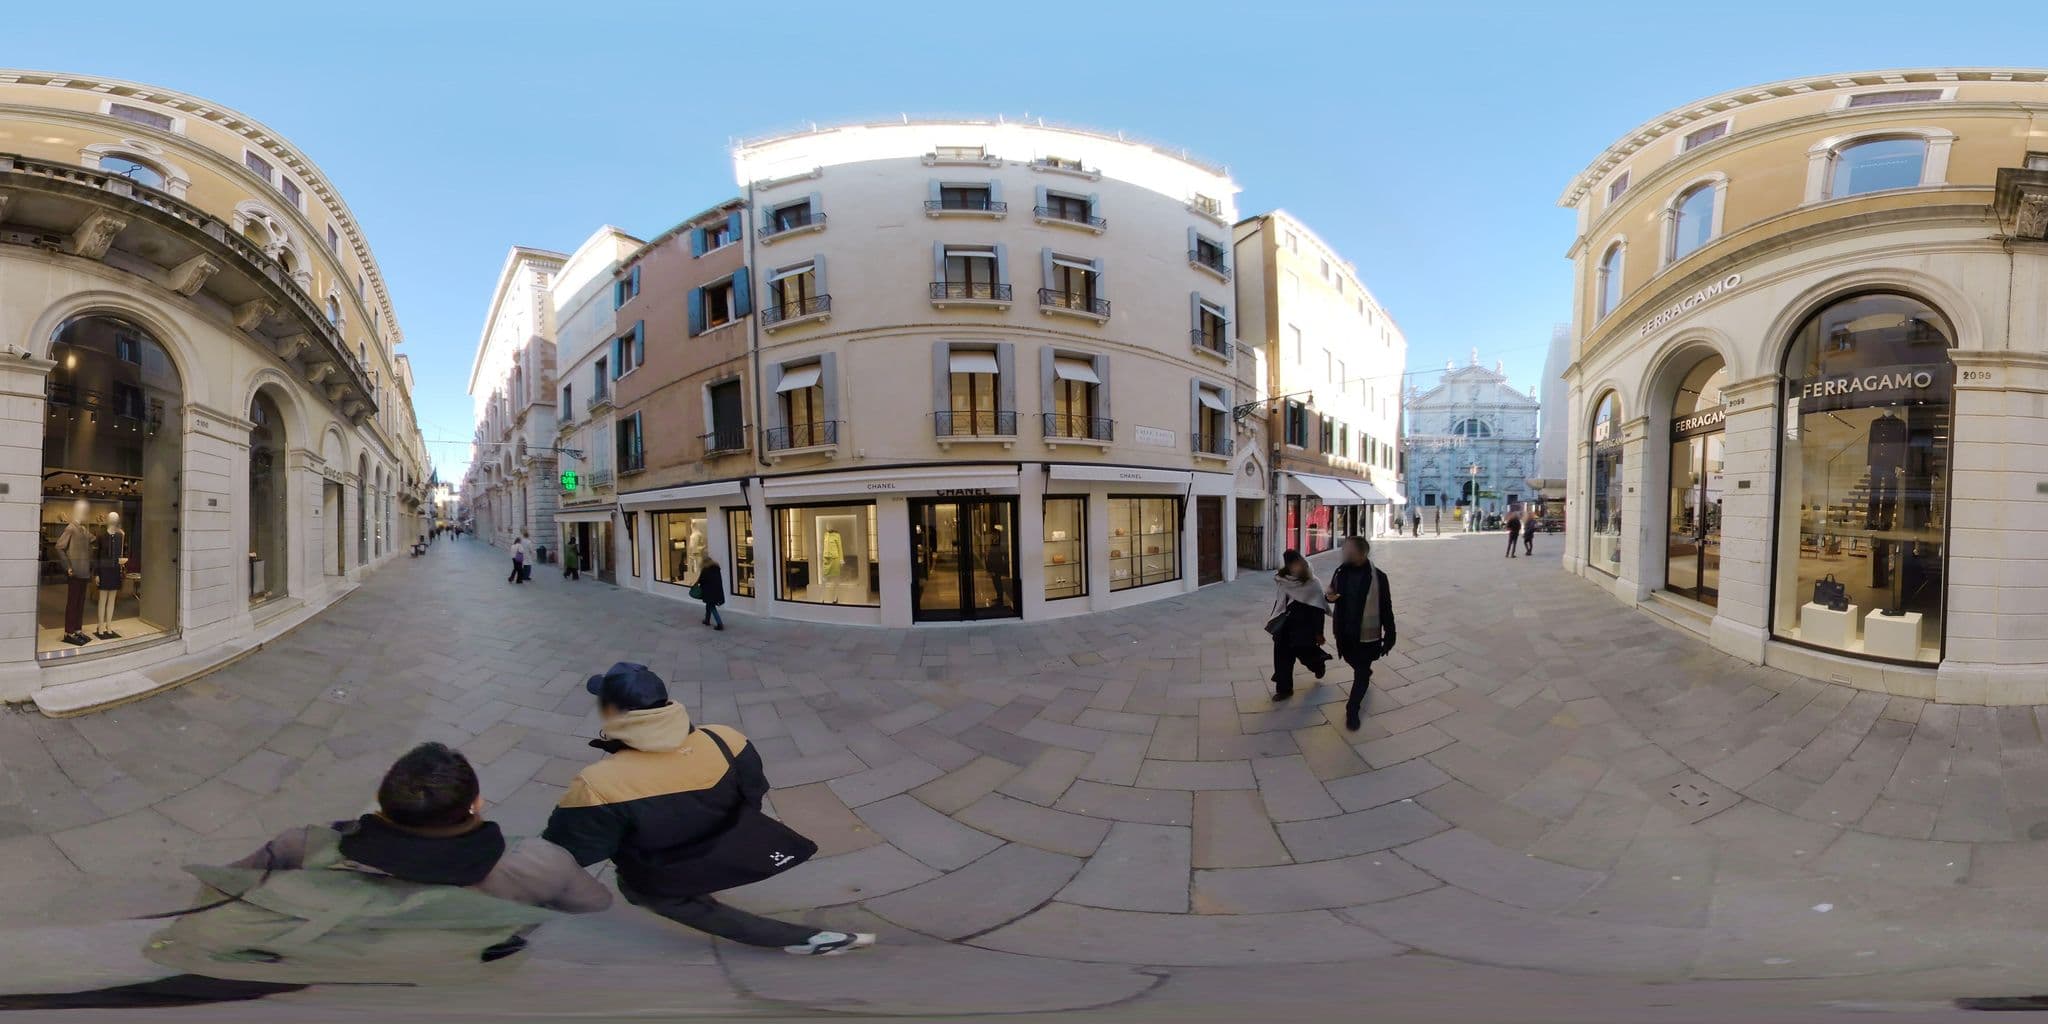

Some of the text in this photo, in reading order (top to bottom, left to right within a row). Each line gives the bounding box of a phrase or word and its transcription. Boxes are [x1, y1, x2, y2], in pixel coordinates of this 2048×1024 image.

[1640, 274, 1742, 337] FERRAGAMO
[1803, 372, 1932, 399] FERRAGAMO
[936, 487, 990, 497] CHANEL
